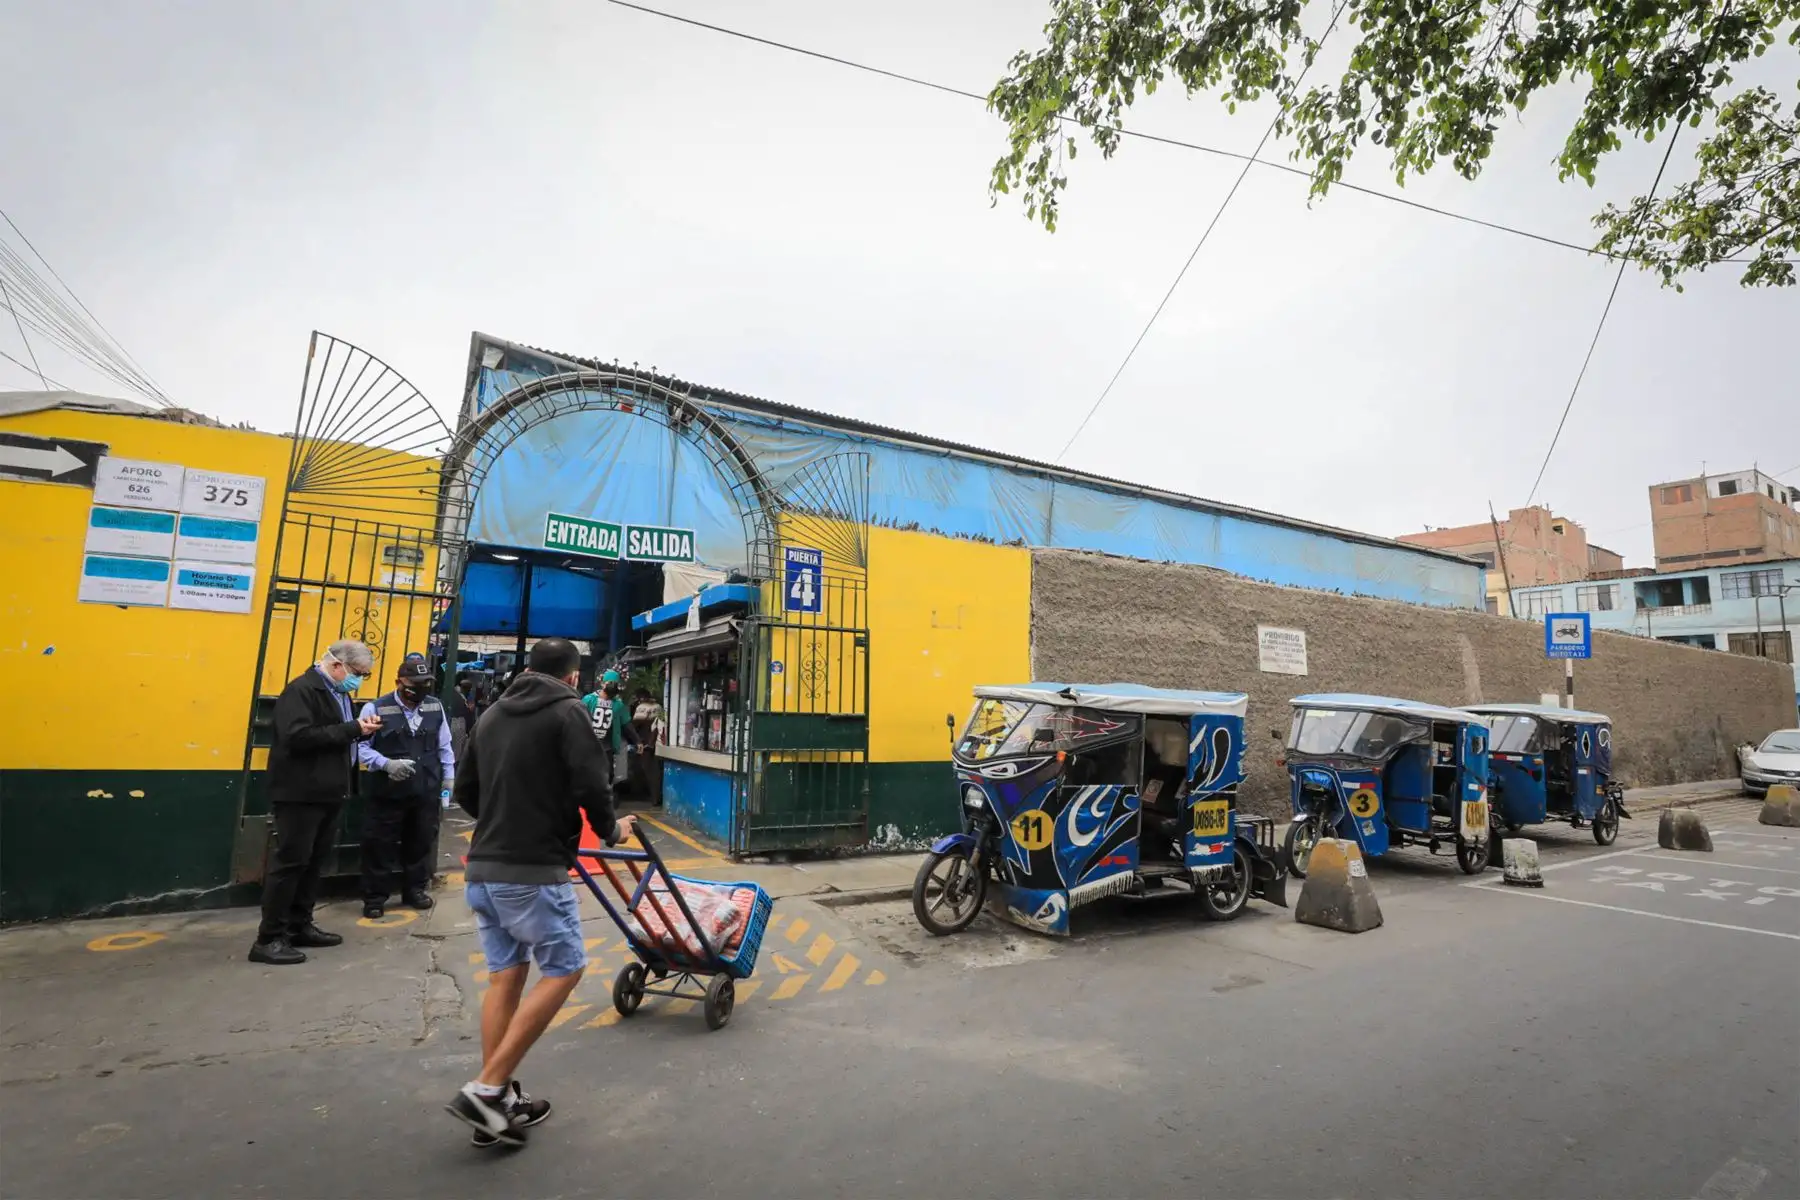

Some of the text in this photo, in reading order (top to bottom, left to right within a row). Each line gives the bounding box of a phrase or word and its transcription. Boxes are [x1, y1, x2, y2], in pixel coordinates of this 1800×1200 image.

[121, 466, 163, 477] AFORO
[128, 484, 151, 494] 626
[203, 485, 249, 506] 375
[547, 519, 617, 552] ENTRADA
[629, 530, 691, 558] SALIDA
[788, 550, 819, 566] PUERTA
[790, 568, 816, 607] 4
[592, 707, 614, 730] 93
[1355, 793, 1371, 813] 3
[1019, 815, 1043, 843] 11
